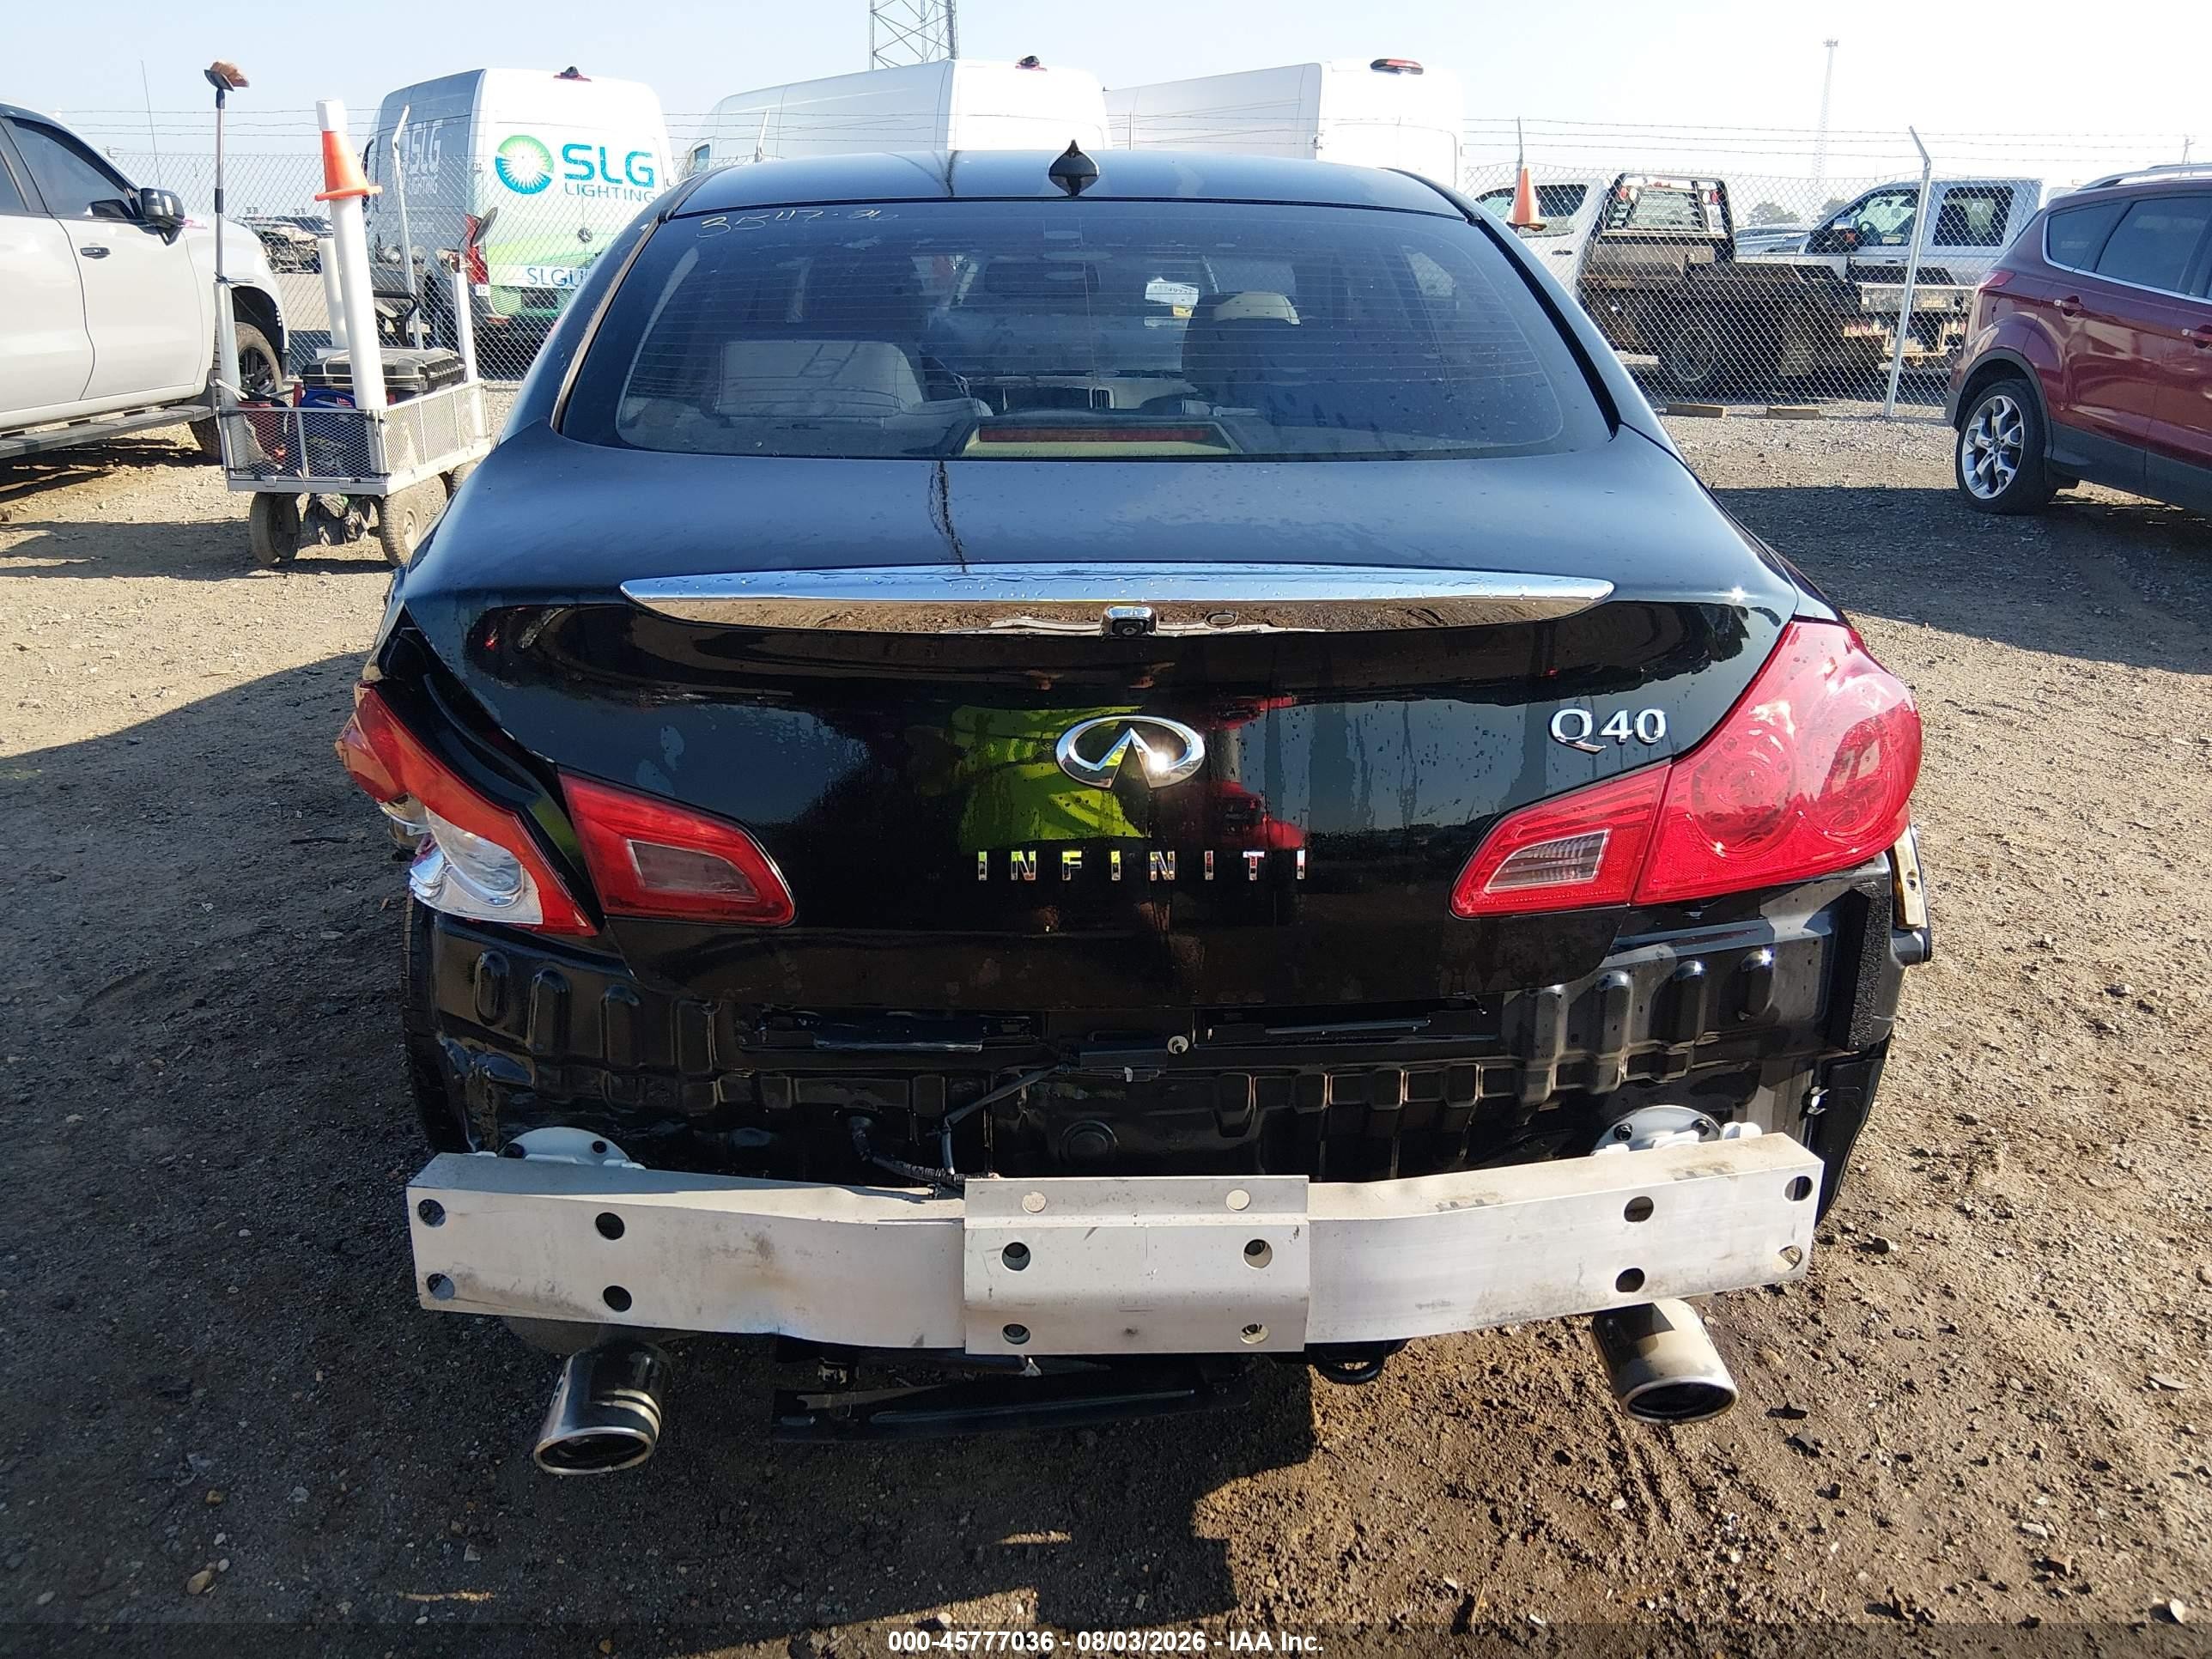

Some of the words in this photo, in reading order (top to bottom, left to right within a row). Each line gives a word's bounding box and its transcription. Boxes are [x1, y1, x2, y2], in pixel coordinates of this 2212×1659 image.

[562, 143, 654, 188] SLG
[564, 182, 656, 204] LIGHTING
[1548, 708, 1667, 755] Q40
[977, 850, 1306, 881] INFINITI
